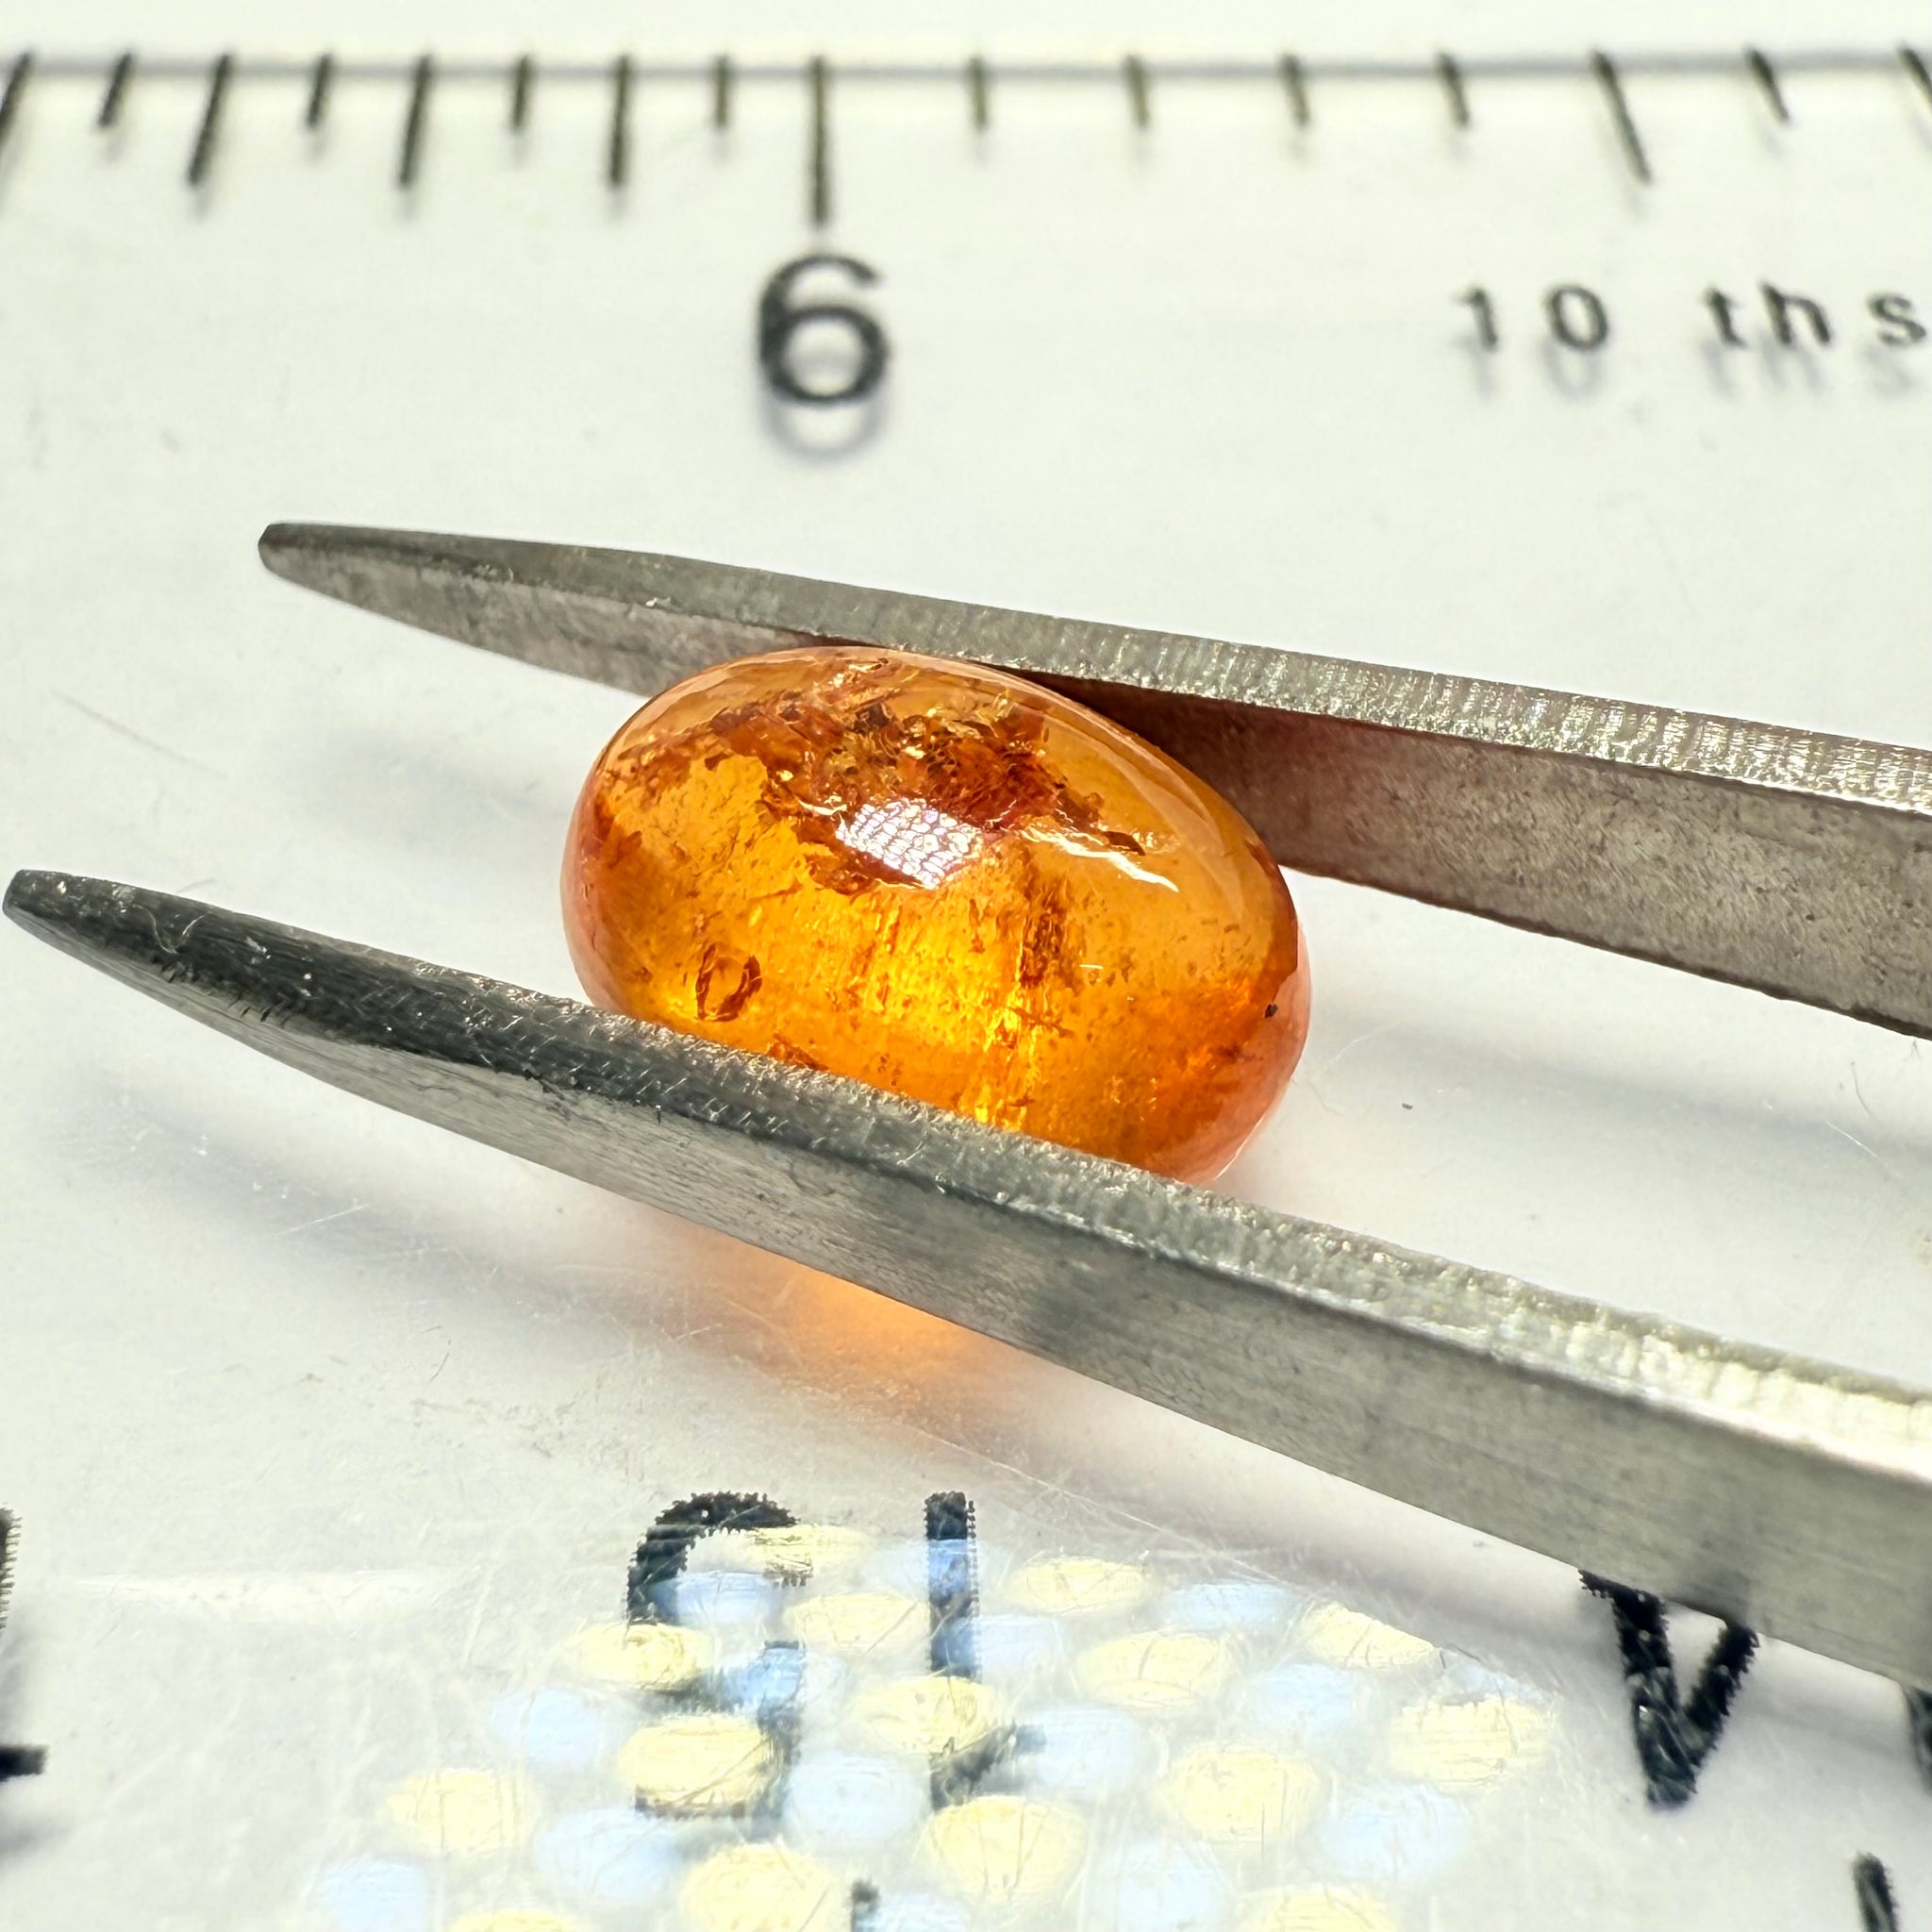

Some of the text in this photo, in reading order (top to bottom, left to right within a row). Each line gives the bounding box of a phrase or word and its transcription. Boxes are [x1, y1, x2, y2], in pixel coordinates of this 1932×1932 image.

[758, 252, 890, 408] 6
[1456, 280, 1928, 350] 10 ths
